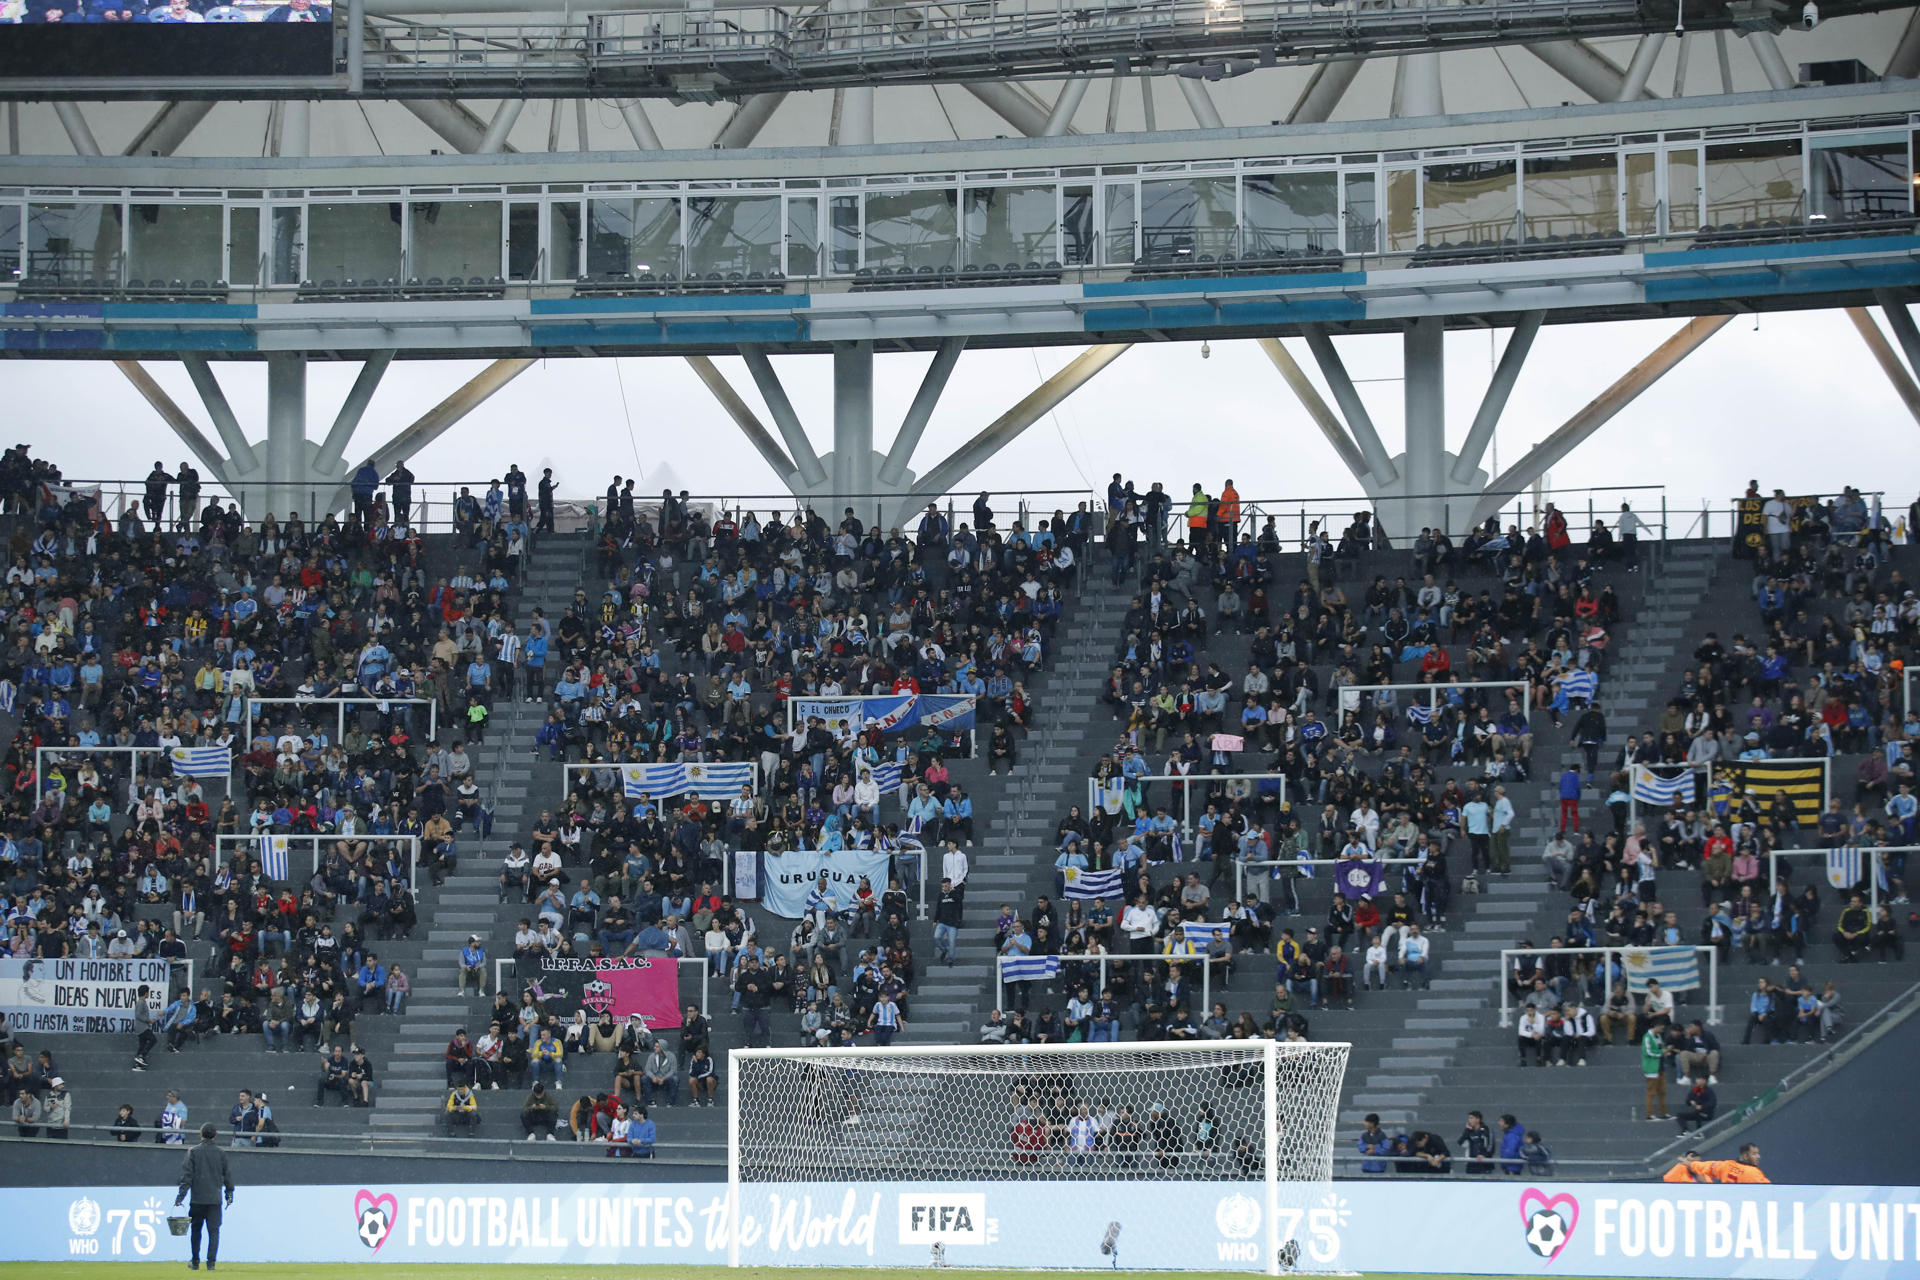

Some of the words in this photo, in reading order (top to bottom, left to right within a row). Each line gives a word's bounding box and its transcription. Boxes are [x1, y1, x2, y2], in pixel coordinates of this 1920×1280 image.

[56, 960, 74, 980] UN
[80, 961, 132, 982] HOMBRE
[138, 962, 166, 982] CON
[55, 984, 89, 1007] IDEAS
[95, 987, 138, 1009] NUEVA
[8, 1012, 29, 1029] OCO
[34, 1013, 69, 1031] HASTA
[85, 1016, 116, 1033] IDEAS
[408, 1197, 569, 1247] FOOTBALL
[577, 1197, 694, 1248] UNITES
[768, 1187, 882, 1256] World
[912, 1206, 974, 1231] FIFA
[1594, 1198, 1817, 1260] FOOTBALL
[107, 1209, 156, 1255] 75
[1276, 1208, 1340, 1263] 75
[69, 1239, 99, 1255] WHO
[1217, 1242, 1259, 1262] WHO
